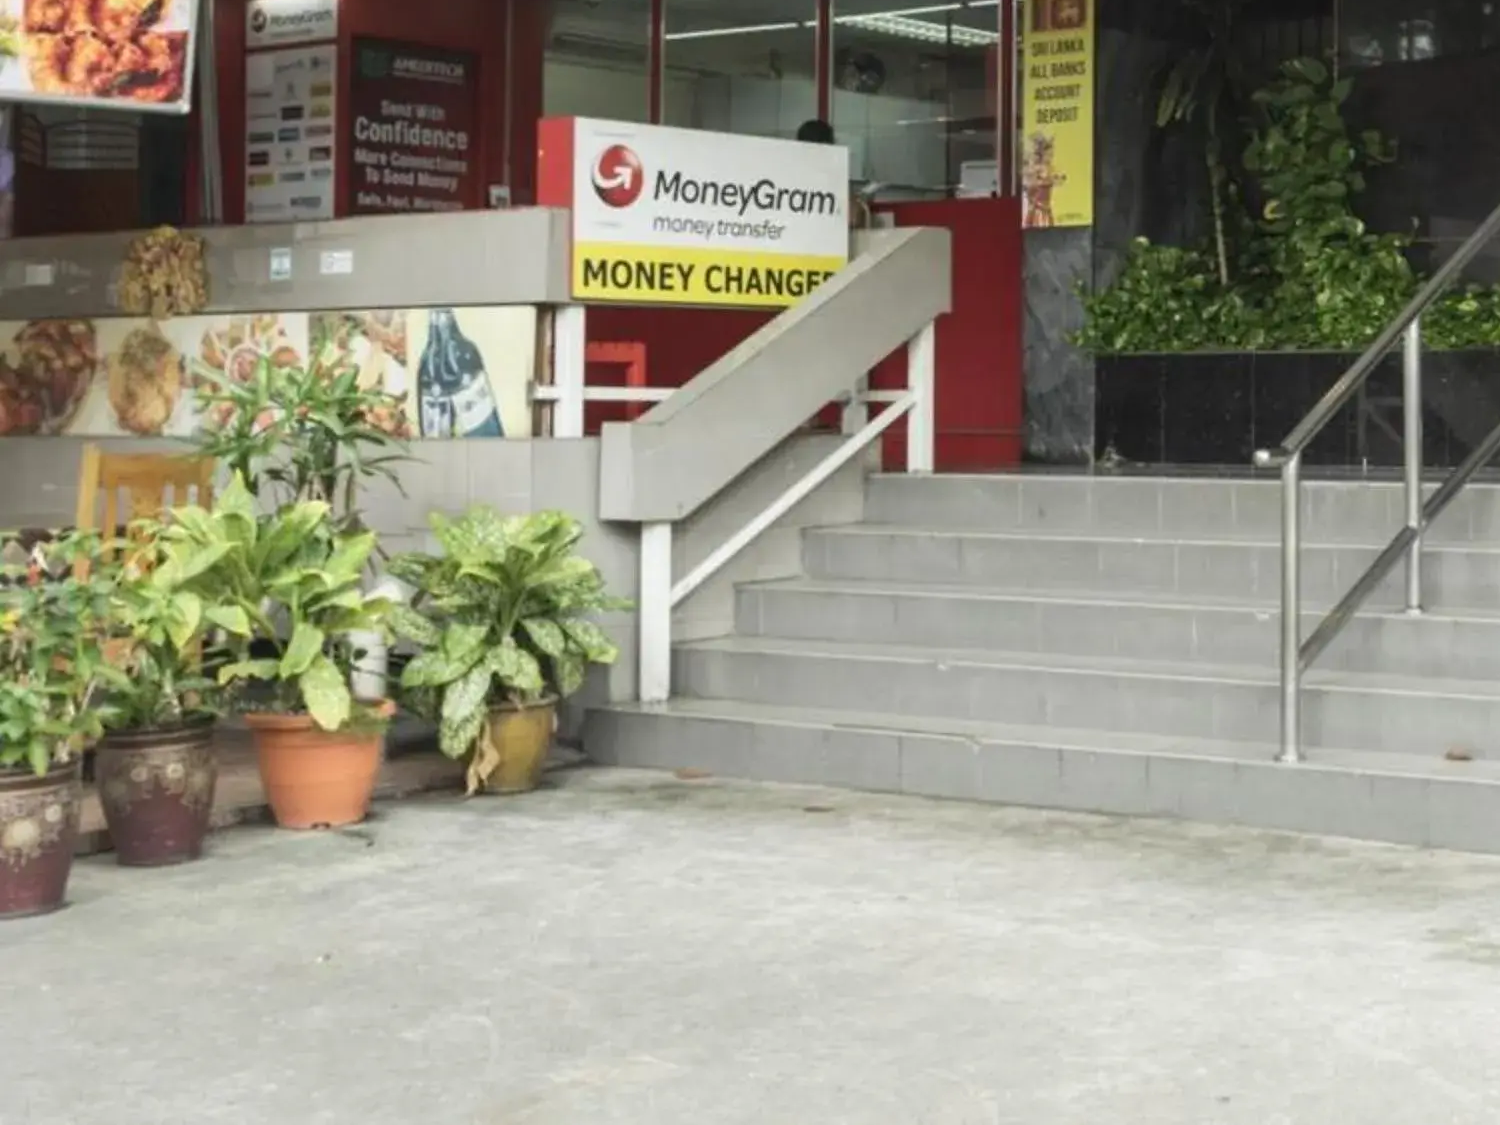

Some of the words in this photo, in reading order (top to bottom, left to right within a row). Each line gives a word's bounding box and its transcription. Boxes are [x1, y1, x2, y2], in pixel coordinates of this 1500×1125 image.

[1051, 38, 1084, 55] LANKA
[1030, 64, 1048, 79] ALL
[1034, 84, 1081, 100] ACCOUNT
[1036, 106, 1079, 124] DEPOSIT
[355, 116, 468, 150] Confidence
[354, 146, 387, 166] More
[366, 166, 380, 184] To
[383, 168, 415, 186] Send
[653, 170, 835, 216] MoneyGram
[652, 216, 714, 239] money
[717, 220, 786, 241] transfer
[583, 258, 695, 292] MONEY
[704, 265, 838, 296] CHANGE
